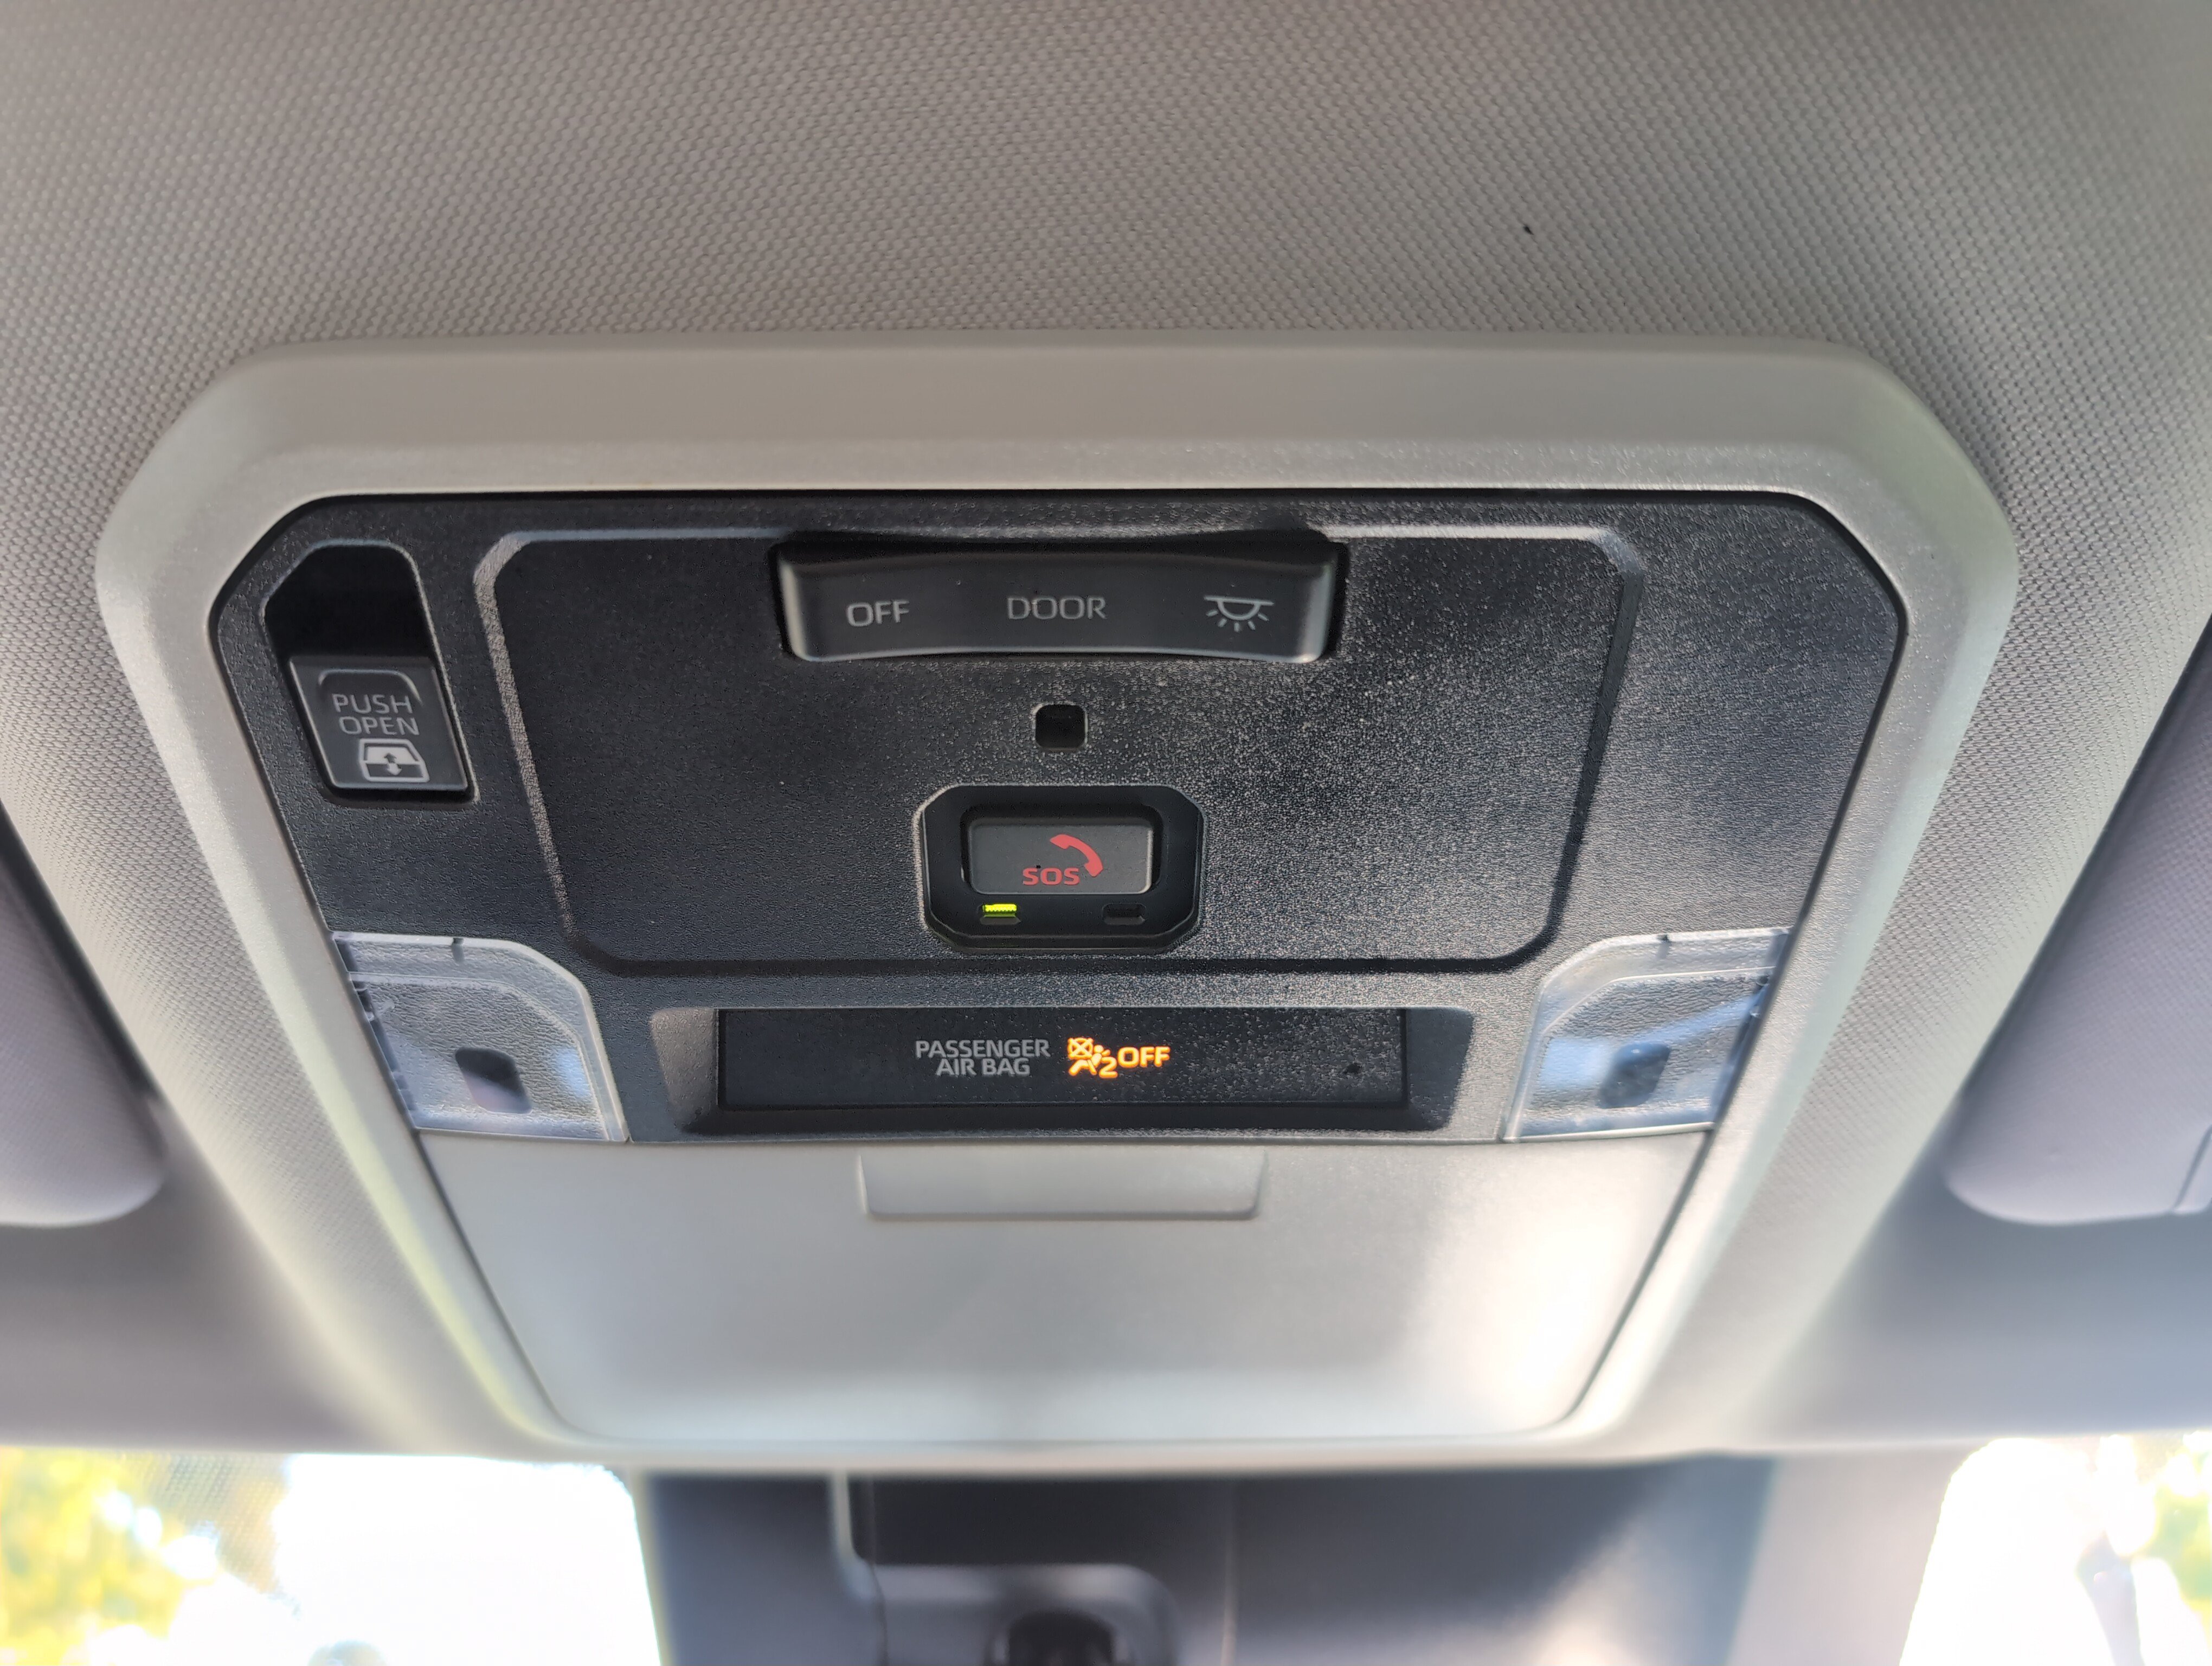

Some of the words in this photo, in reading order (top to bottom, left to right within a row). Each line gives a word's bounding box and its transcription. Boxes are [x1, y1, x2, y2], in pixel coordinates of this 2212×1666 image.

[846, 599, 909, 626] OFF
[1007, 597, 1107, 619] DOOR
[332, 693, 413, 714] PUSH
[339, 716, 420, 735] OPEN
[1022, 868, 1080, 886] SOS
[915, 1039, 1051, 1058] PASSENGER
[936, 1058, 976, 1076] AIR
[981, 1058, 1031, 1075] BAG
